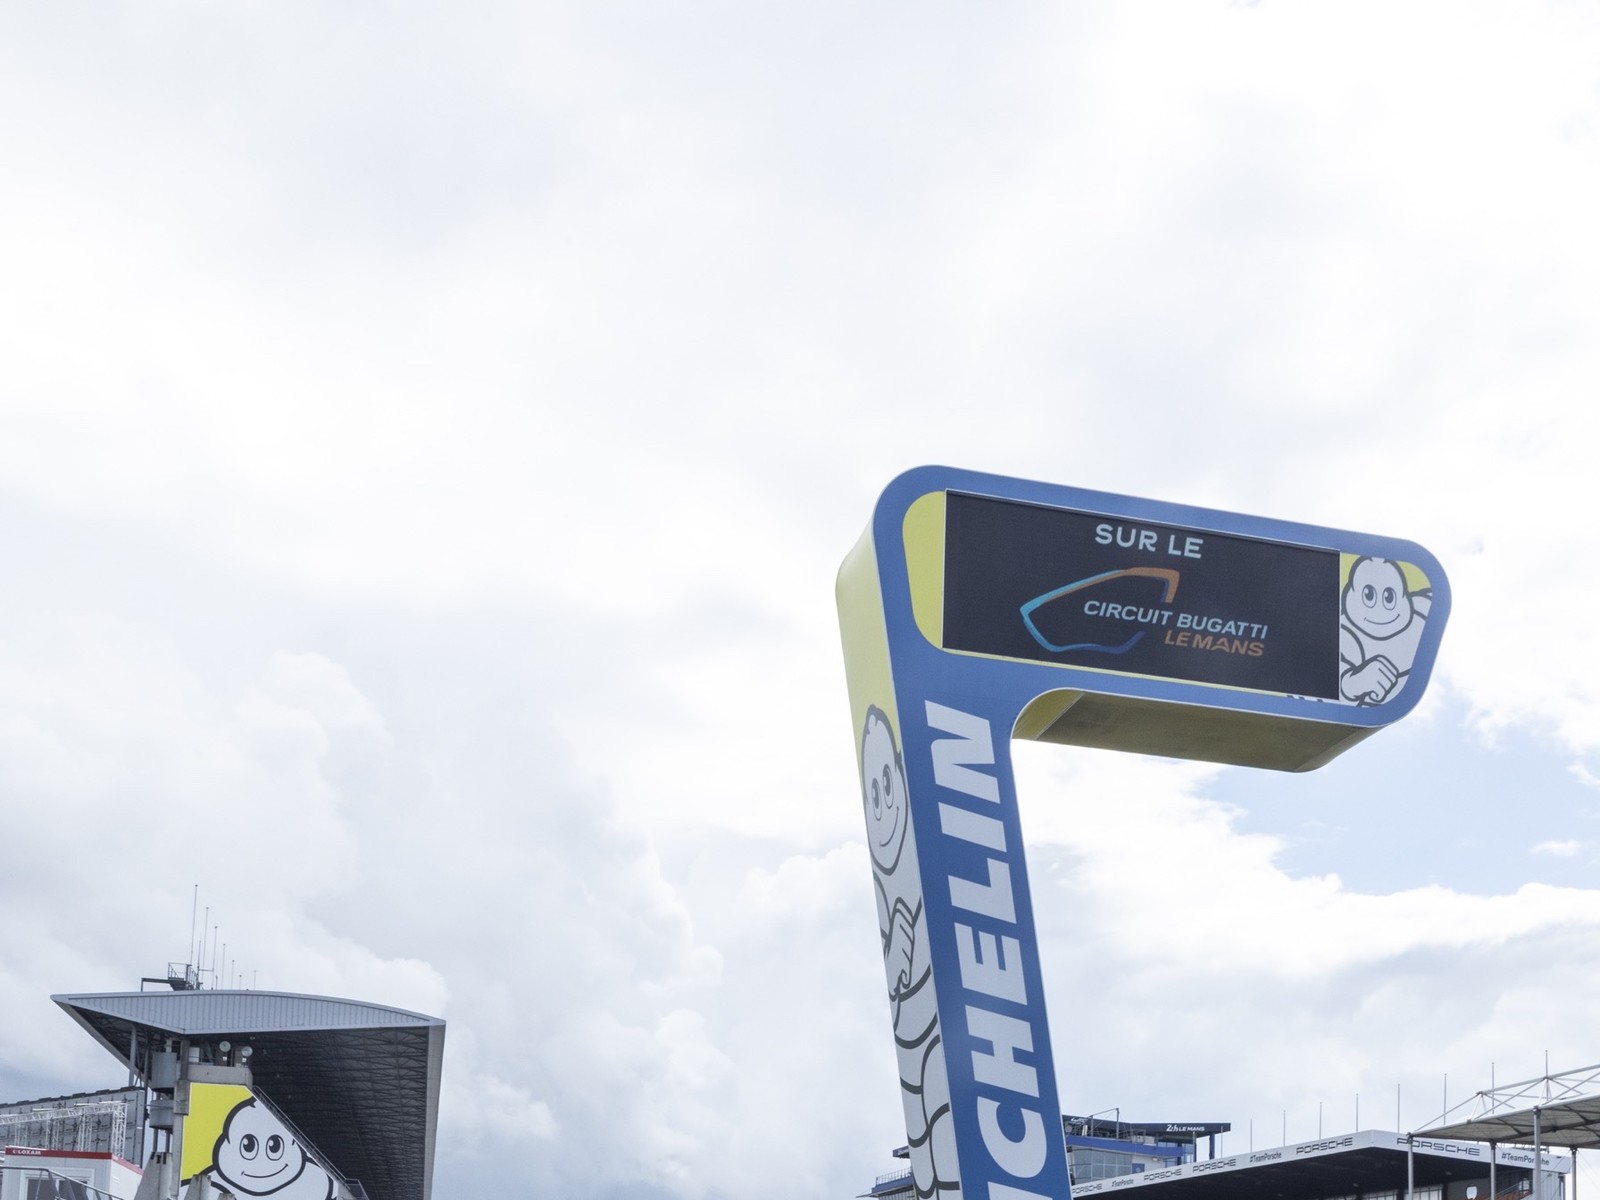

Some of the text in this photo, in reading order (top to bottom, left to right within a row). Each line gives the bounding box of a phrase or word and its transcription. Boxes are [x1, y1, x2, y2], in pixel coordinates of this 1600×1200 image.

[1094, 523, 1204, 559] SUR LE
[1083, 600, 1268, 639] CIRCUIT BUGATTI
[1164, 630, 1265, 657] LE MANS
[1296, 1136, 1354, 1156] PORSCHE
[1396, 1137, 1481, 1157] PORSCHE
[1193, 1158, 1237, 1173] PORSCHE
[1249, 1151, 1283, 1163] #TeamPorsche
[1501, 1152, 1550, 1166] #TeamPorhe
[1143, 1168, 1183, 1182] PORSCHE
[1072, 1183, 1103, 1195] PORSCHE
